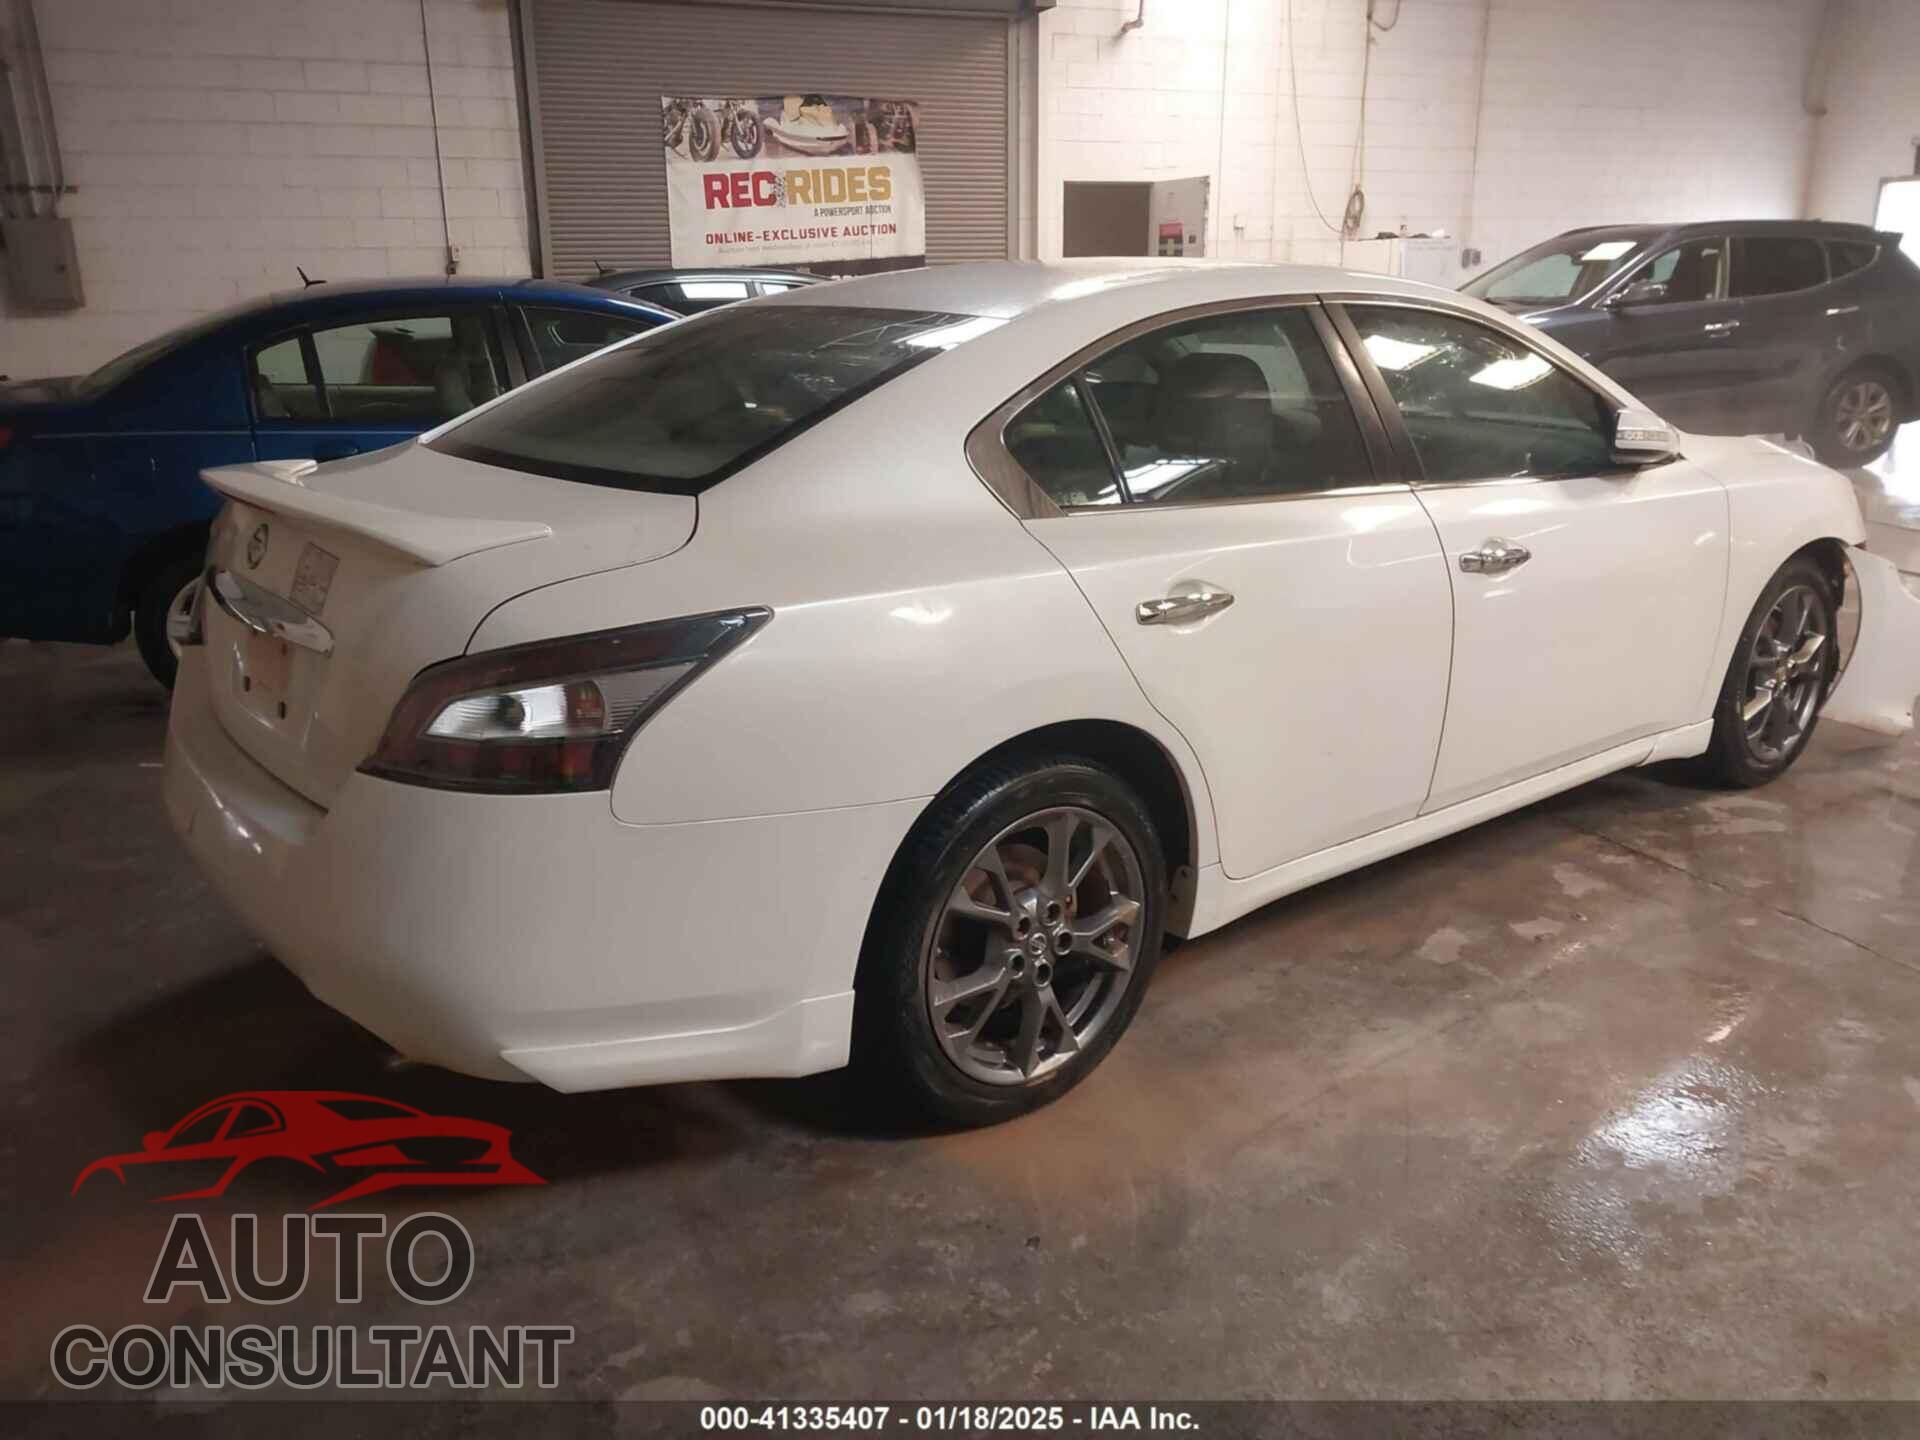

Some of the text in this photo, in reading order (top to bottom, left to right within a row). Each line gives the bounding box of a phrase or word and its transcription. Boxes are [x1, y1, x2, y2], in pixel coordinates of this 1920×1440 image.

[703, 171, 777, 209] REC
[785, 166, 892, 205] RIDES
[821, 206, 863, 217] POWERSPORT
[865, 205, 892, 215] AUCTION
[705, 223, 897, 245] ONLINE-EXCLUSIVE AUCTION
